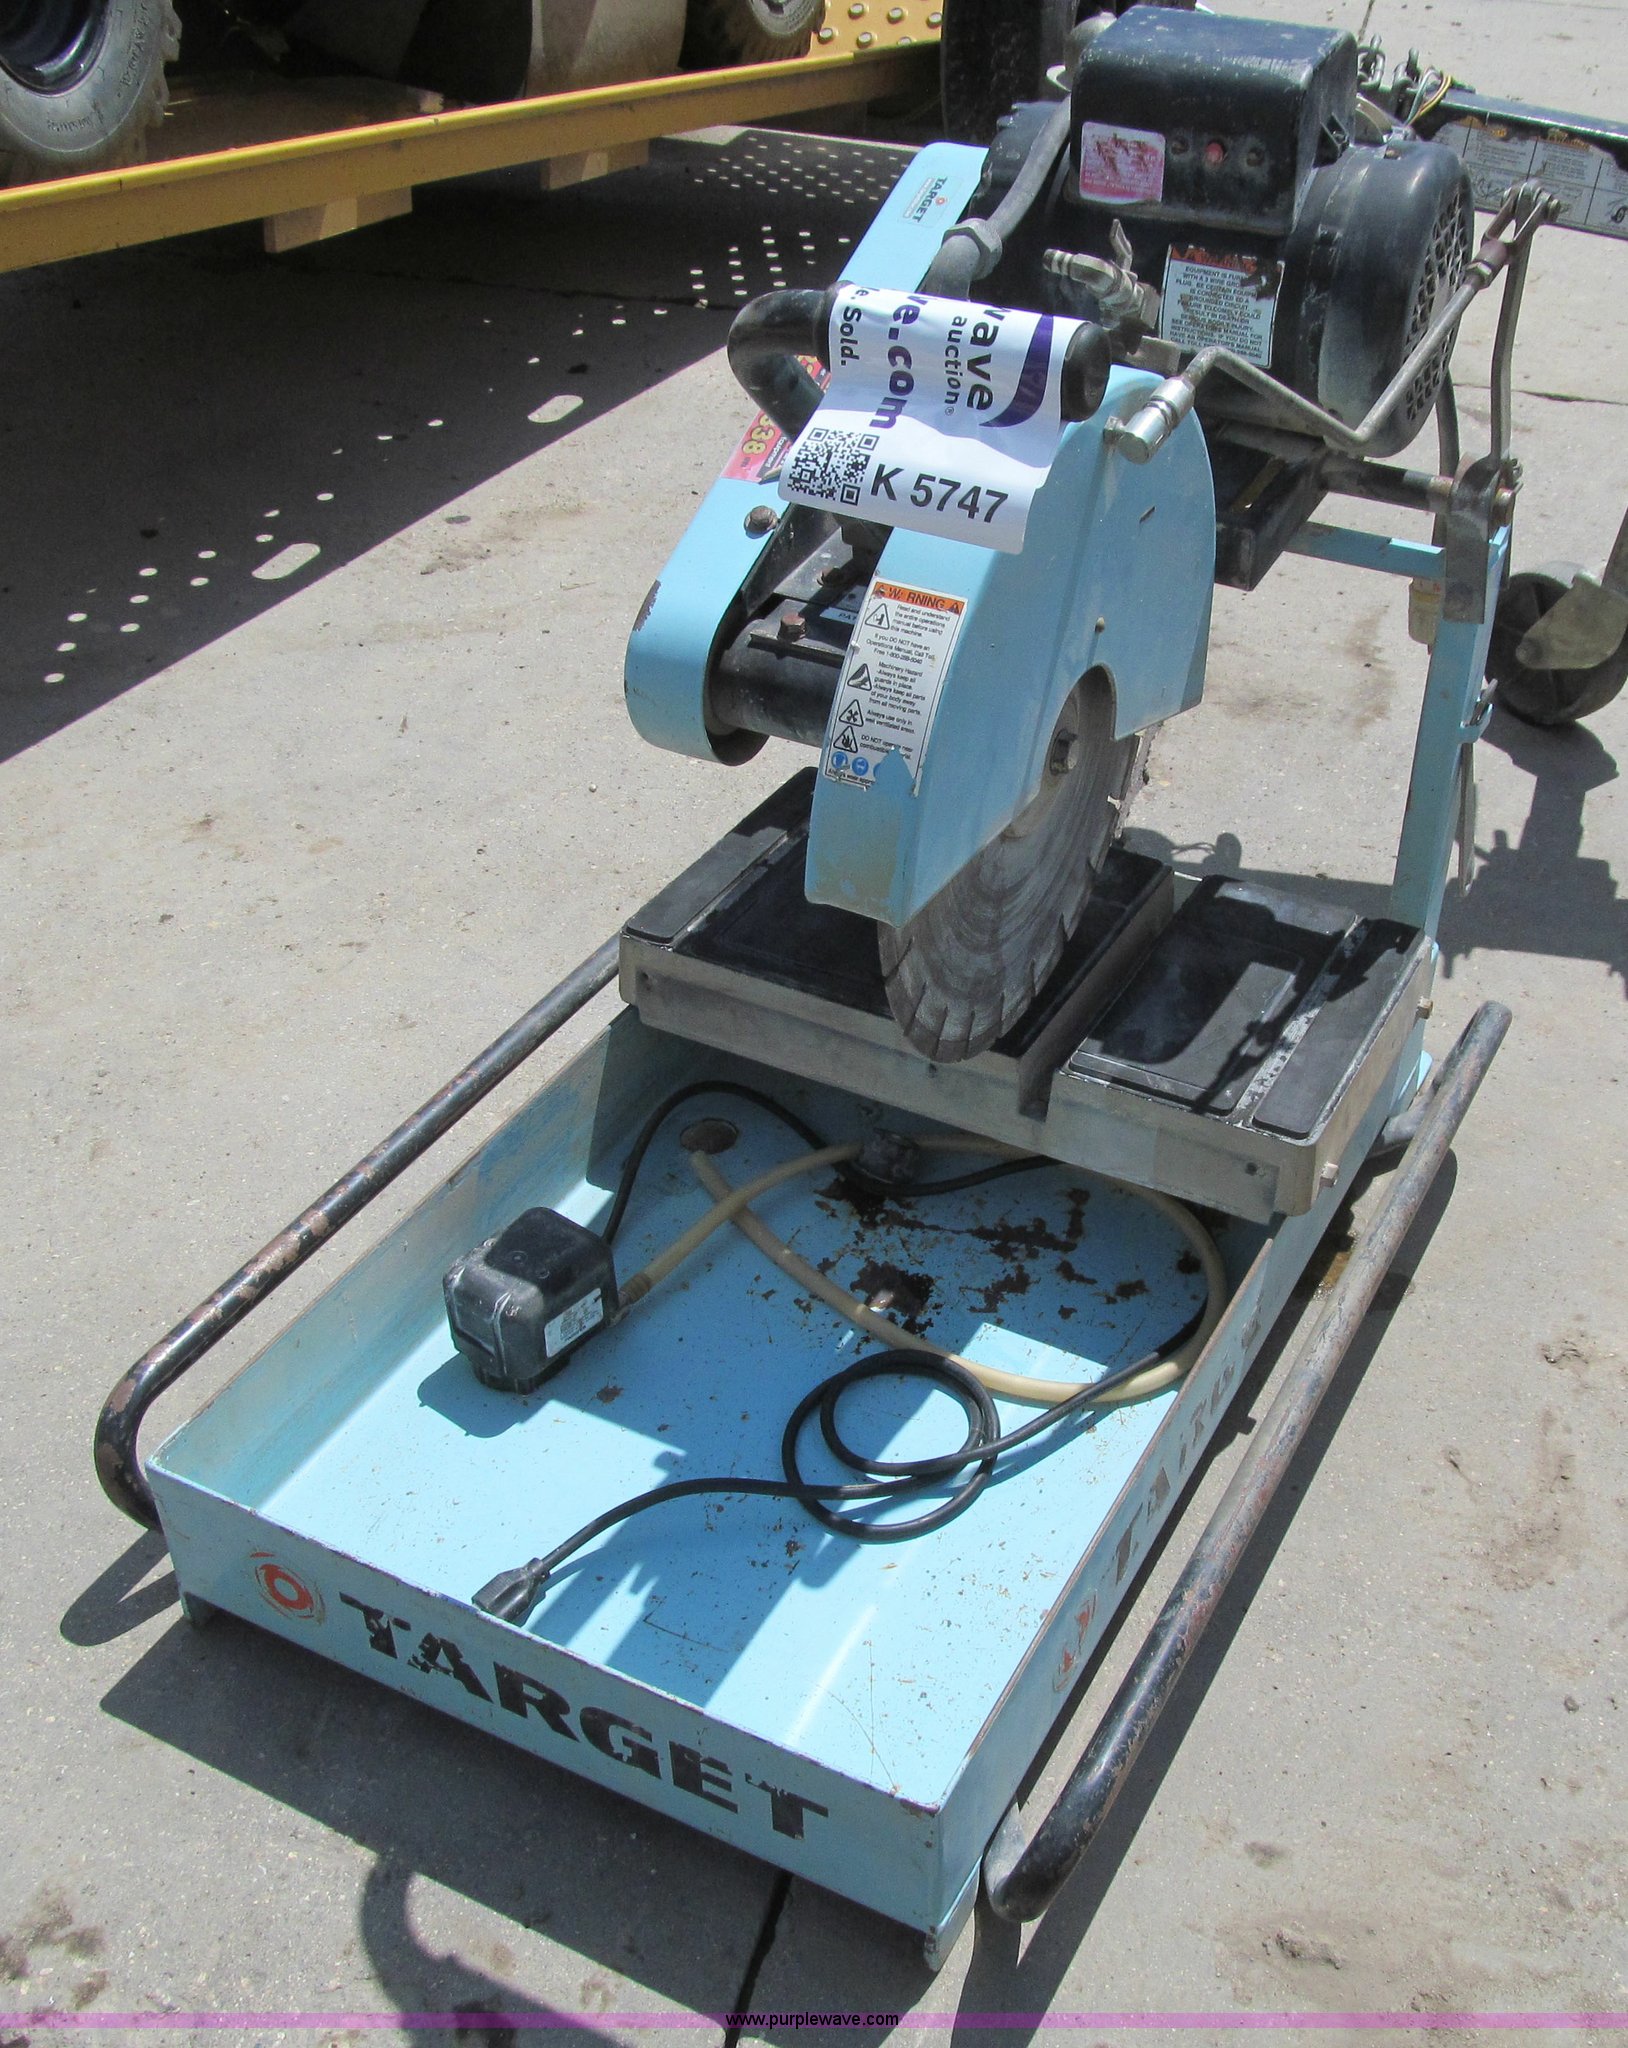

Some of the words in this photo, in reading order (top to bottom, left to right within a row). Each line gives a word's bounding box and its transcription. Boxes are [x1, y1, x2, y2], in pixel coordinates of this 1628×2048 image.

[912, 177, 947, 222] TARGET
[1185, 266, 1219, 277] EQUIPMENT
[839, 305, 863, 366] Sold.
[870, 463, 904, 502] K
[909, 473, 1009, 524] 5747
[887, 587, 945, 609] WRNING
[896, 604, 910, 612] Read
[921, 610, 950, 621] understand
[892, 618, 910, 627] manual
[911, 623, 927, 631] before
[928, 627, 943, 635] using
[903, 613, 917, 621] entire
[918, 617, 945, 628] operations
[900, 628, 922, 637] machine.
[865, 638, 893, 650] Operations
[893, 645, 914, 655] Manual,
[897, 638, 909, 646] NOT
[873, 647, 885, 655] Free
[878, 661, 904, 673] Machinery
[904, 668, 923, 677] Hazard
[874, 675, 892, 685] guards
[898, 681, 912, 690] place.
[896, 674, 909, 682] keep
[888, 695, 900, 703] body
[901, 698, 915, 707] away
[892, 688, 905, 696] keep
[912, 693, 925, 701] parts
[868, 697, 880, 705] from
[887, 702, 906, 712] moving
[866, 709, 885, 719] Always
[885, 714, 895, 722] use
[895, 717, 906, 725] only
[870, 736, 881, 744] NOT
[339, 1592, 829, 1840] TARGET
